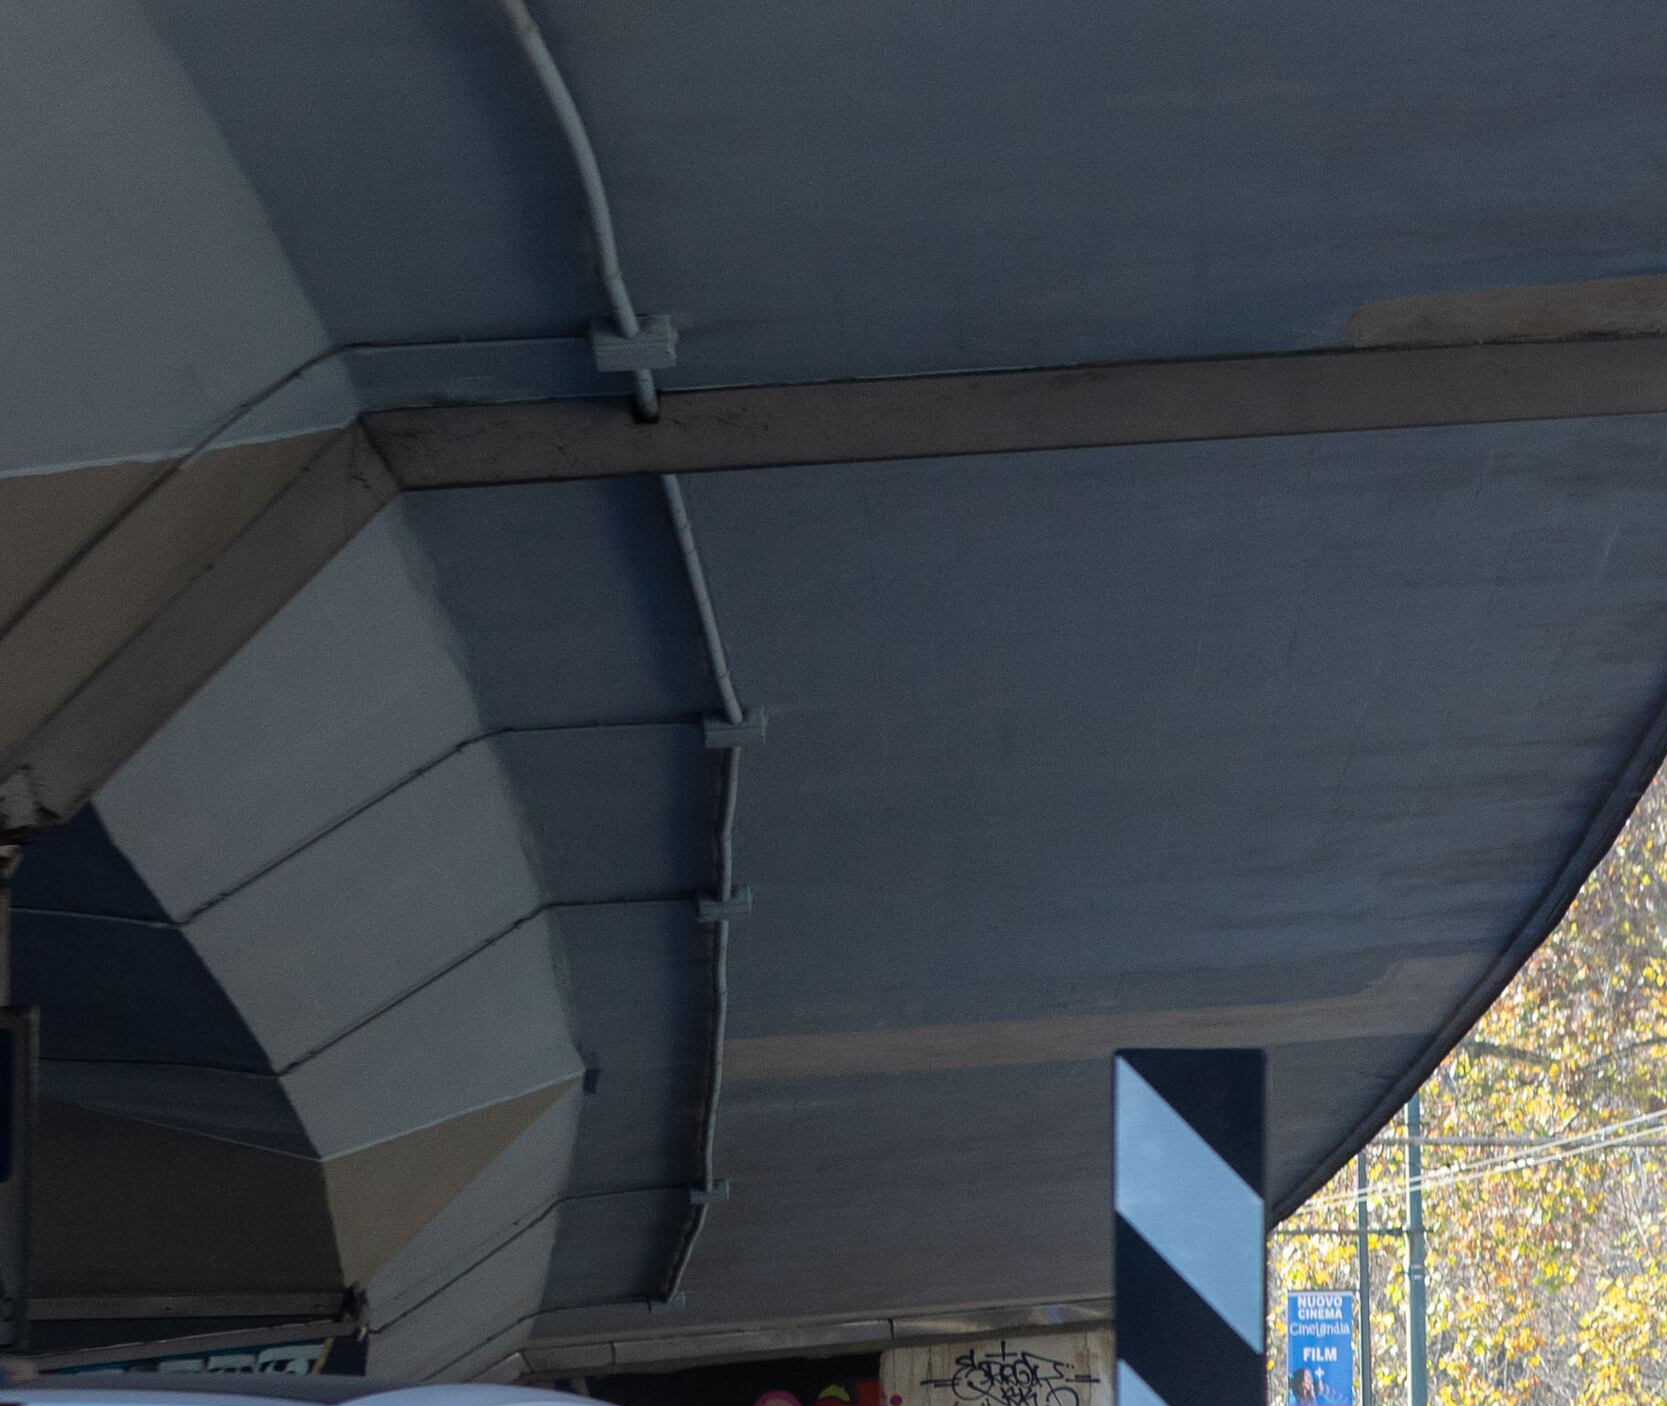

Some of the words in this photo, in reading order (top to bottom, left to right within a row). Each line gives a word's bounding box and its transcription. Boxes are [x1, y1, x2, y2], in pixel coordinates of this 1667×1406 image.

[1297, 1295, 1343, 1309] NUOVO
[1298, 1308, 1343, 1320] CINEMA
[1303, 1346, 1338, 1362] FILM
